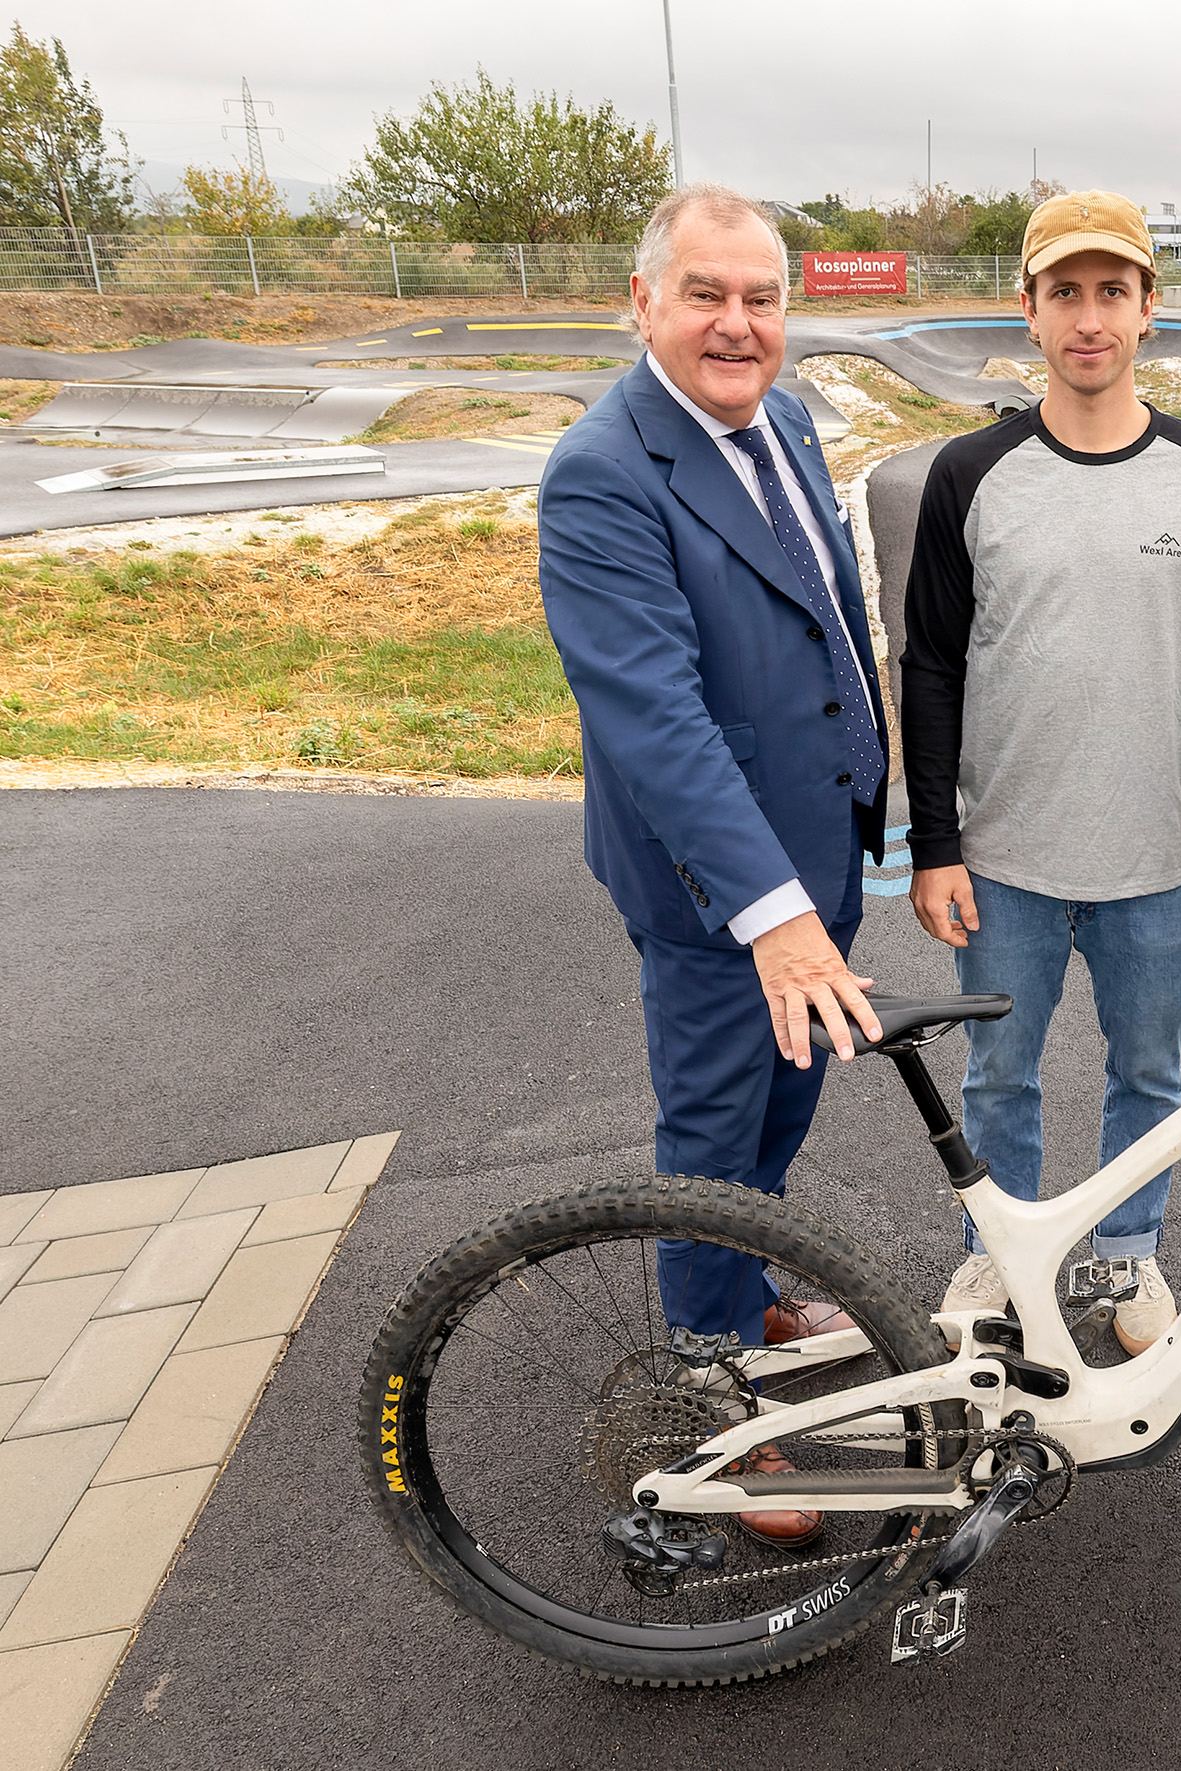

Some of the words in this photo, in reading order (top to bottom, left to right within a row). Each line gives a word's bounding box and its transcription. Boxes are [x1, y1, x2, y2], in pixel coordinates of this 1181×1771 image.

[814, 257, 896, 276] kosaplaner
[857, 282, 897, 290] Generalplanung
[1140, 545, 1164, 556] Wexl
[380, 1374, 406, 1493] MAXXIS
[768, 1606, 798, 1636] DT
[801, 1576, 851, 1621] SWISS
